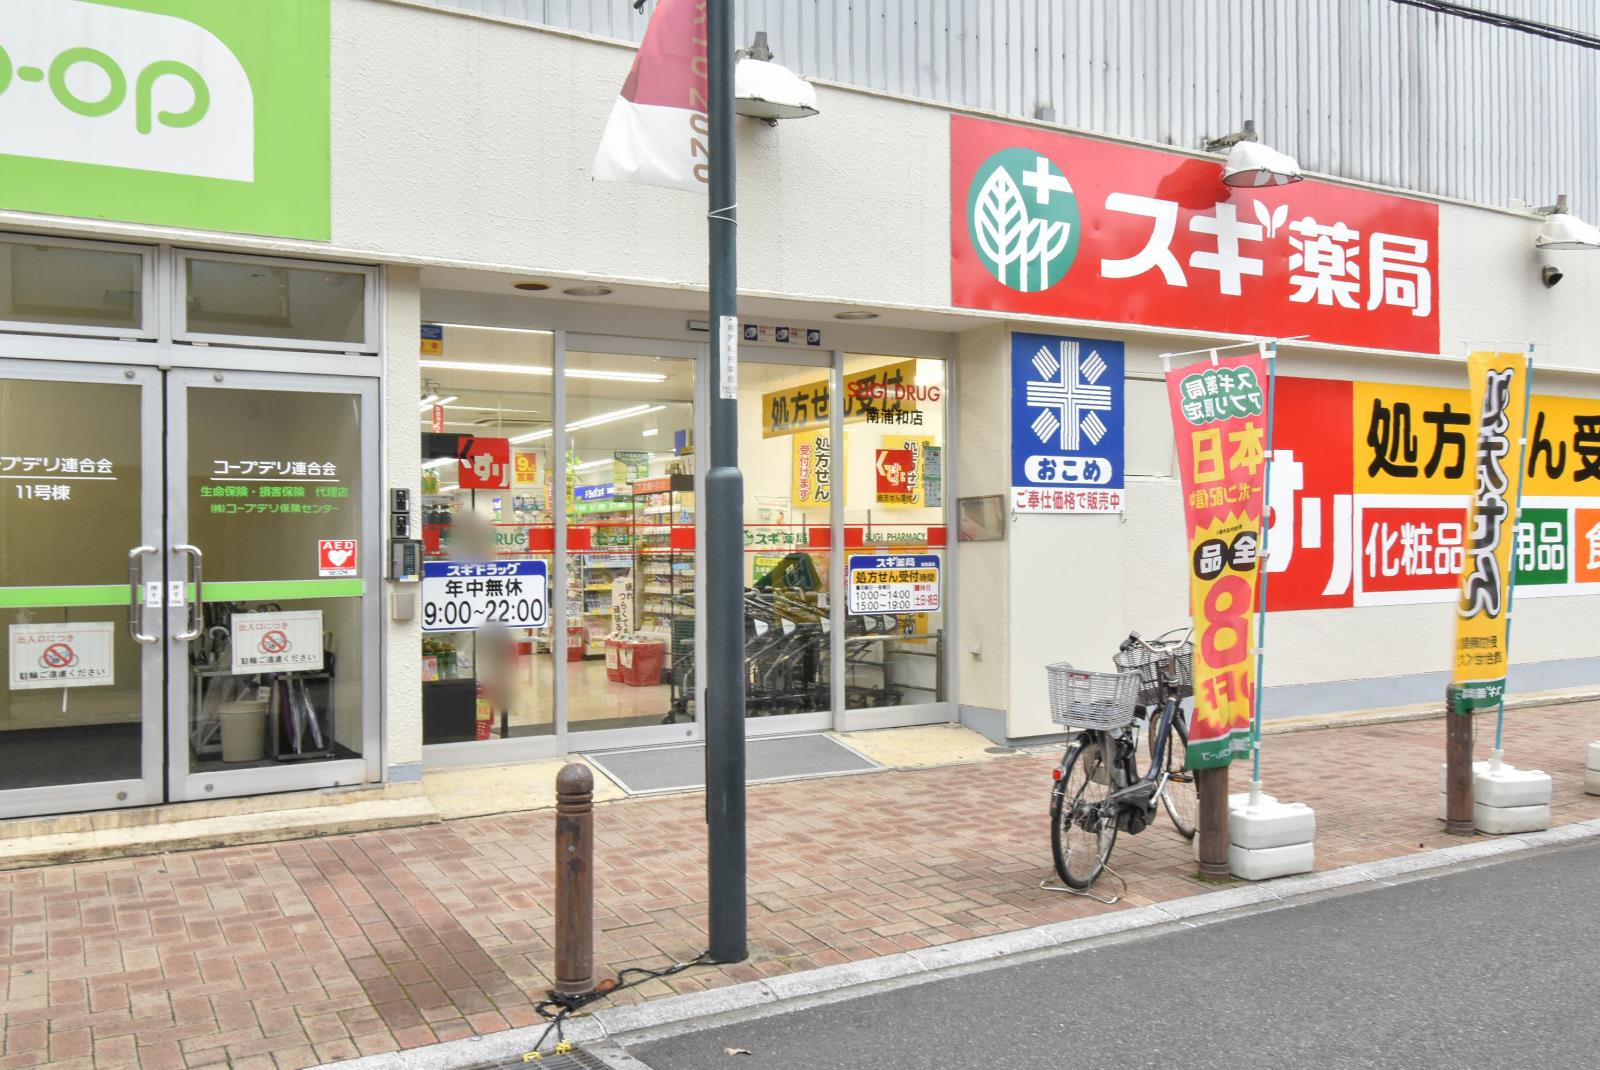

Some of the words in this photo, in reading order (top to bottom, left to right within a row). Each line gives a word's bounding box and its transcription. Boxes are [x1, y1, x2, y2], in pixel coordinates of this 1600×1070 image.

[0, 47, 210, 135] -op
[1101, 192, 1432, 317] スギ薬局
[847, 381, 889, 400] SUGI
[894, 384, 941, 402] DRUG
[866, 408, 924, 427] 南浦和店
[214, 460, 337, 476] コープデリ連合会
[1037, 458, 1101, 482] おこめ
[16, 485, 71, 501] 11号棟
[201, 485, 305, 498] 生命保険・損害保険
[315, 486, 350, 498] 代理店
[1016, 489, 1120, 511] ご奉仕価格で販売中
[322, 541, 354, 550] AED
[886, 532, 926, 541] PHARMACY
[1364, 521, 1466, 579] 化粧品
[446, 562, 521, 577] スギドラッグ
[445, 577, 523, 598] 年中無休
[19, 668, 107, 681] 駐輪ご遠慮ください
